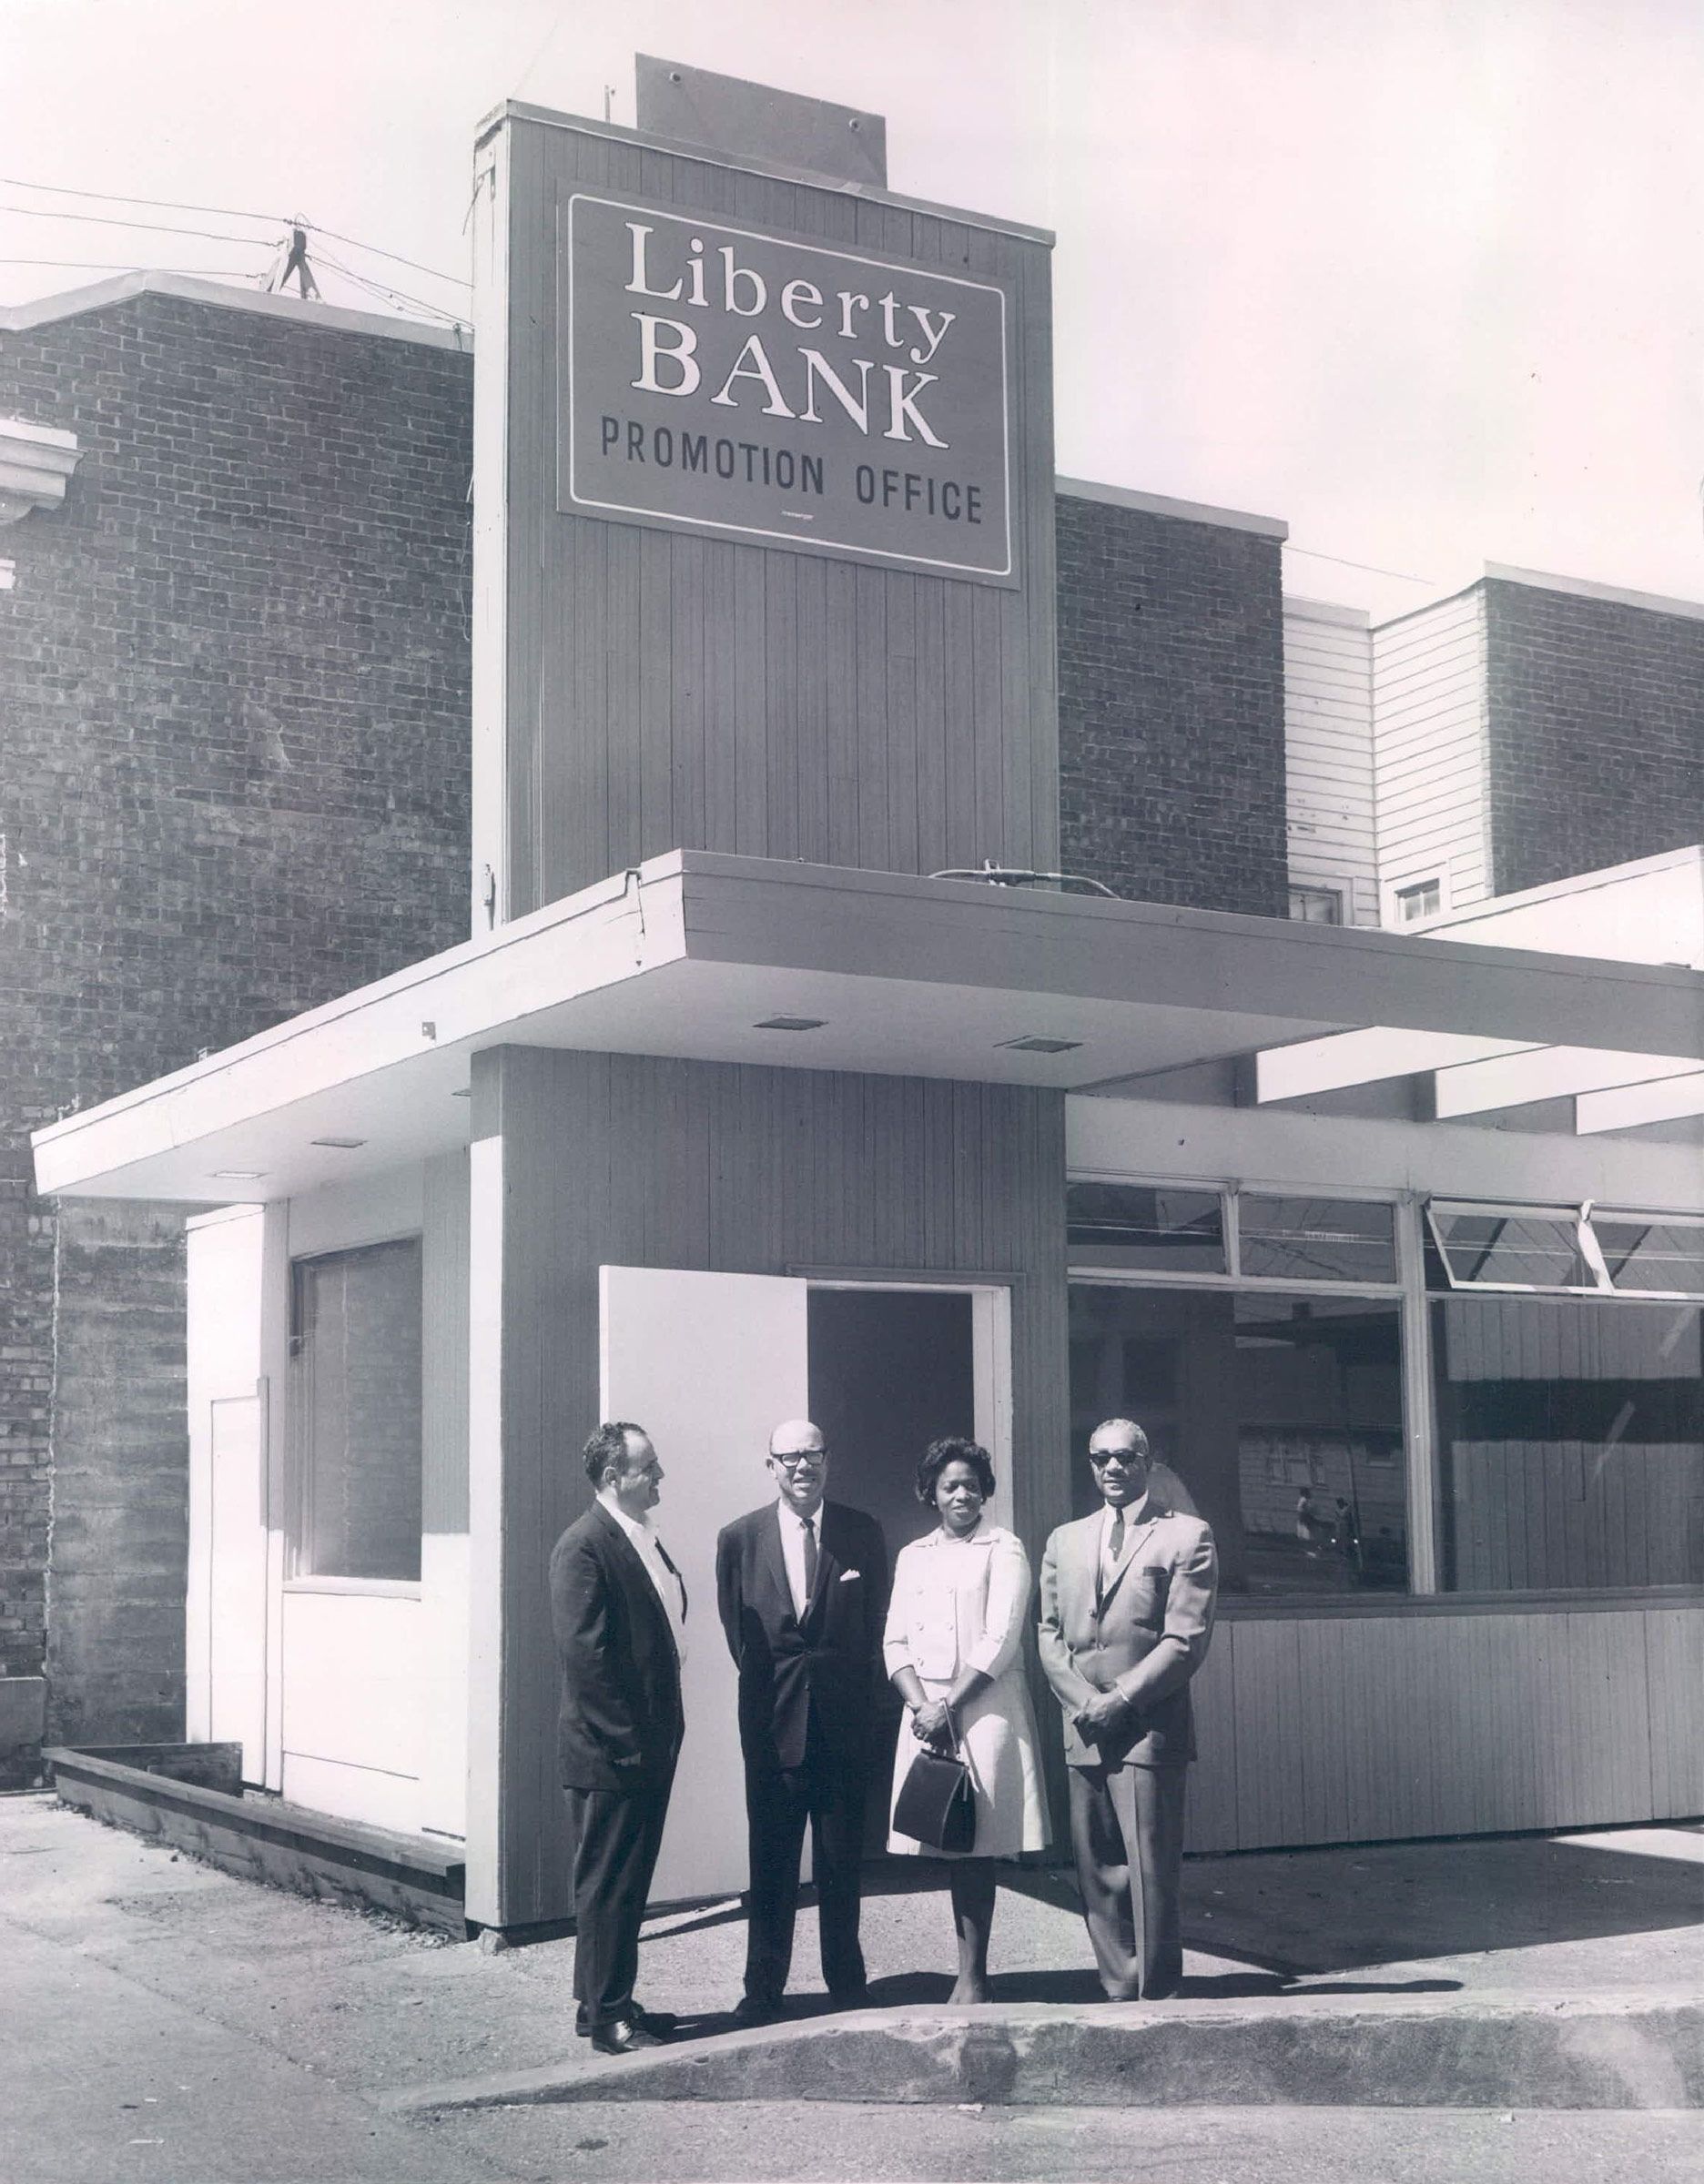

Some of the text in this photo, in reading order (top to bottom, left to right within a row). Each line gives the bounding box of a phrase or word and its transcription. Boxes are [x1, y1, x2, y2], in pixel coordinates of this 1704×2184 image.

[624, 222, 956, 364] Liberty
[631, 311, 949, 449] BANK
[602, 415, 982, 525] PROMOTION OFFICE
